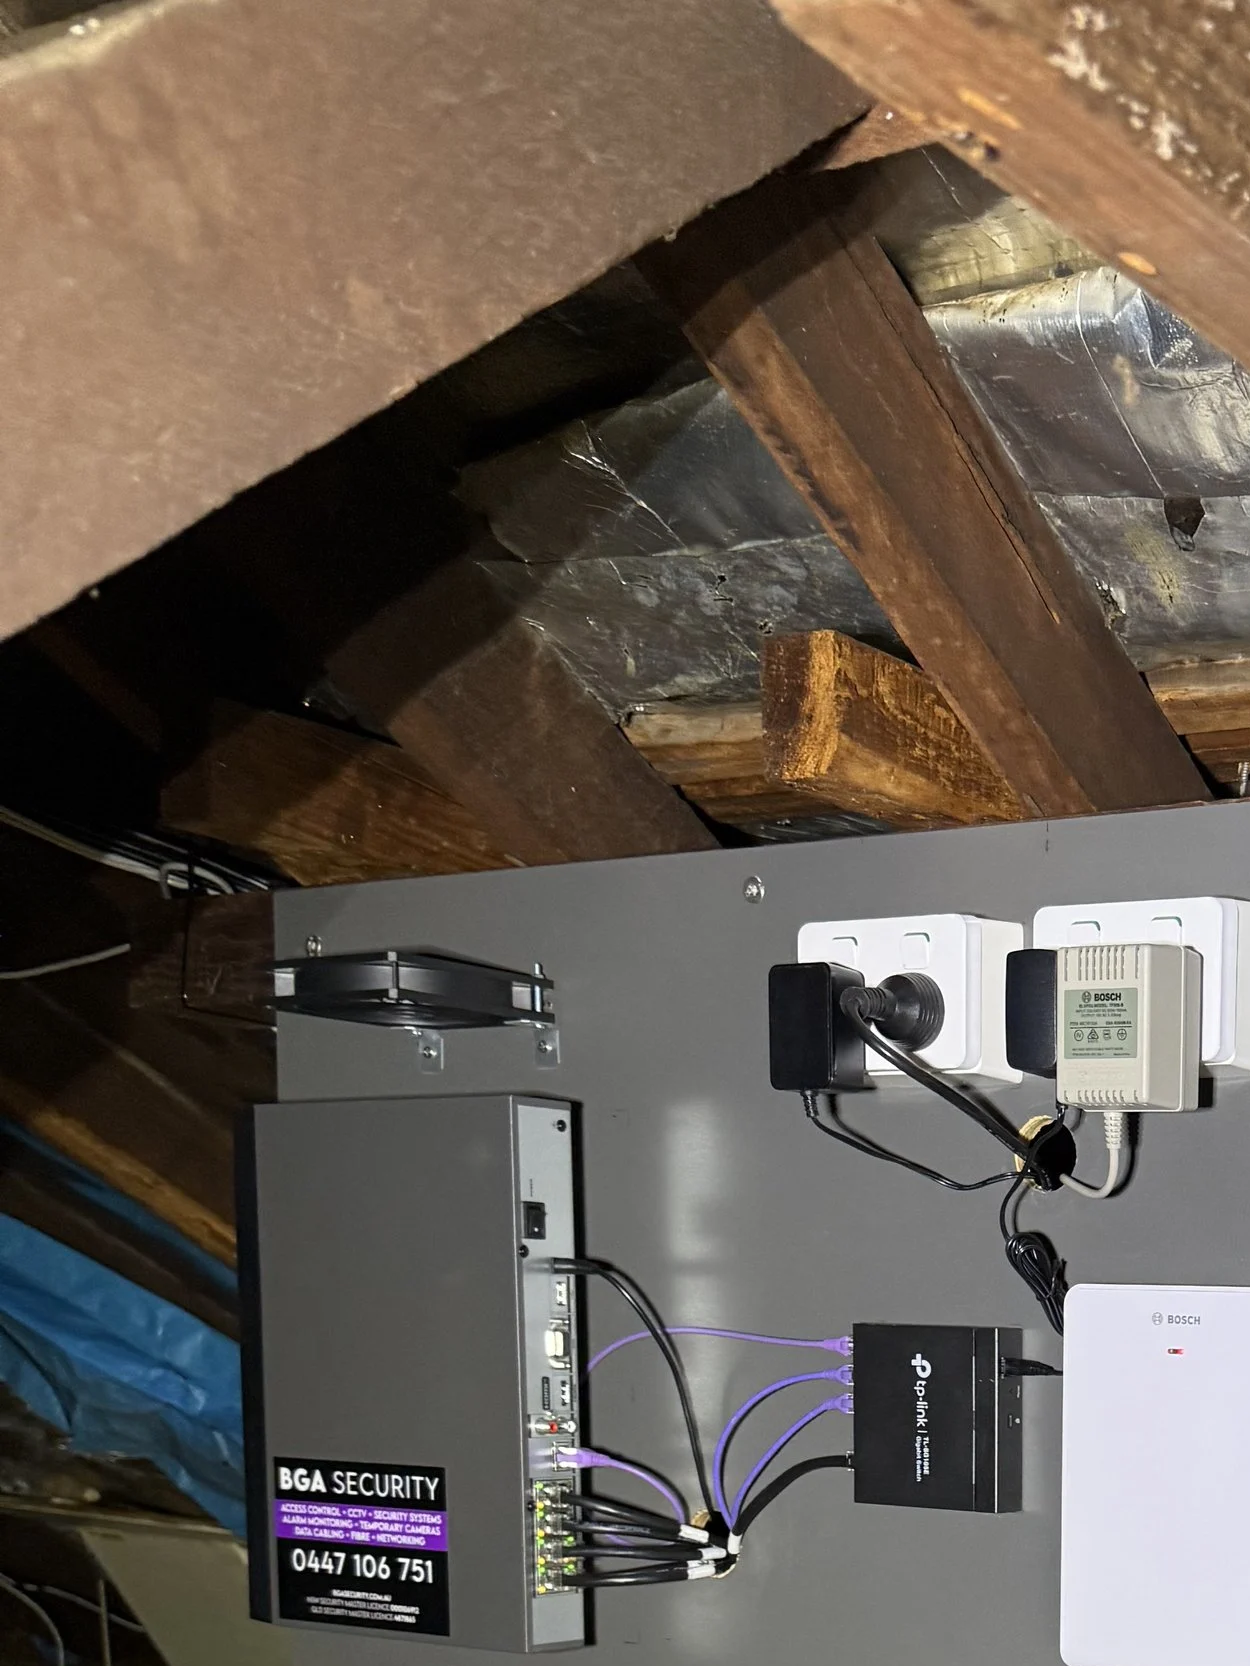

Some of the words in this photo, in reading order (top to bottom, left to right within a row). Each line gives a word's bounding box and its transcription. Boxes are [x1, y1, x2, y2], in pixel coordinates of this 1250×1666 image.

[1094, 993, 1121, 1001] BOSCH
[1167, 1315, 1201, 1325] BOSCH
[279, 1467, 327, 1492] BGA
[332, 1471, 439, 1501] SECURITY
[281, 1503, 307, 1513] ACCESS
[308, 1505, 341, 1516] CONTROL
[347, 1508, 367, 1518] CCTV
[374, 1510, 408, 1521] SECURITY
[410, 1513, 442, 1524] SYSTEMS
[282, 1515, 307, 1524] ALARM
[308, 1517, 353, 1528] MONITORING
[359, 1521, 403, 1532] TEMPORARY
[405, 1525, 441, 1535] CAMERAS
[295, 1527, 313, 1536] DATA
[314, 1528, 344, 1539] CABLING
[351, 1531, 371, 1541] FIBRE
[377, 1534, 425, 1546] NETWORKING
[292, 1548, 346, 1575] 0447
[353, 1554, 391, 1579] 106
[396, 1557, 434, 1584] 751
